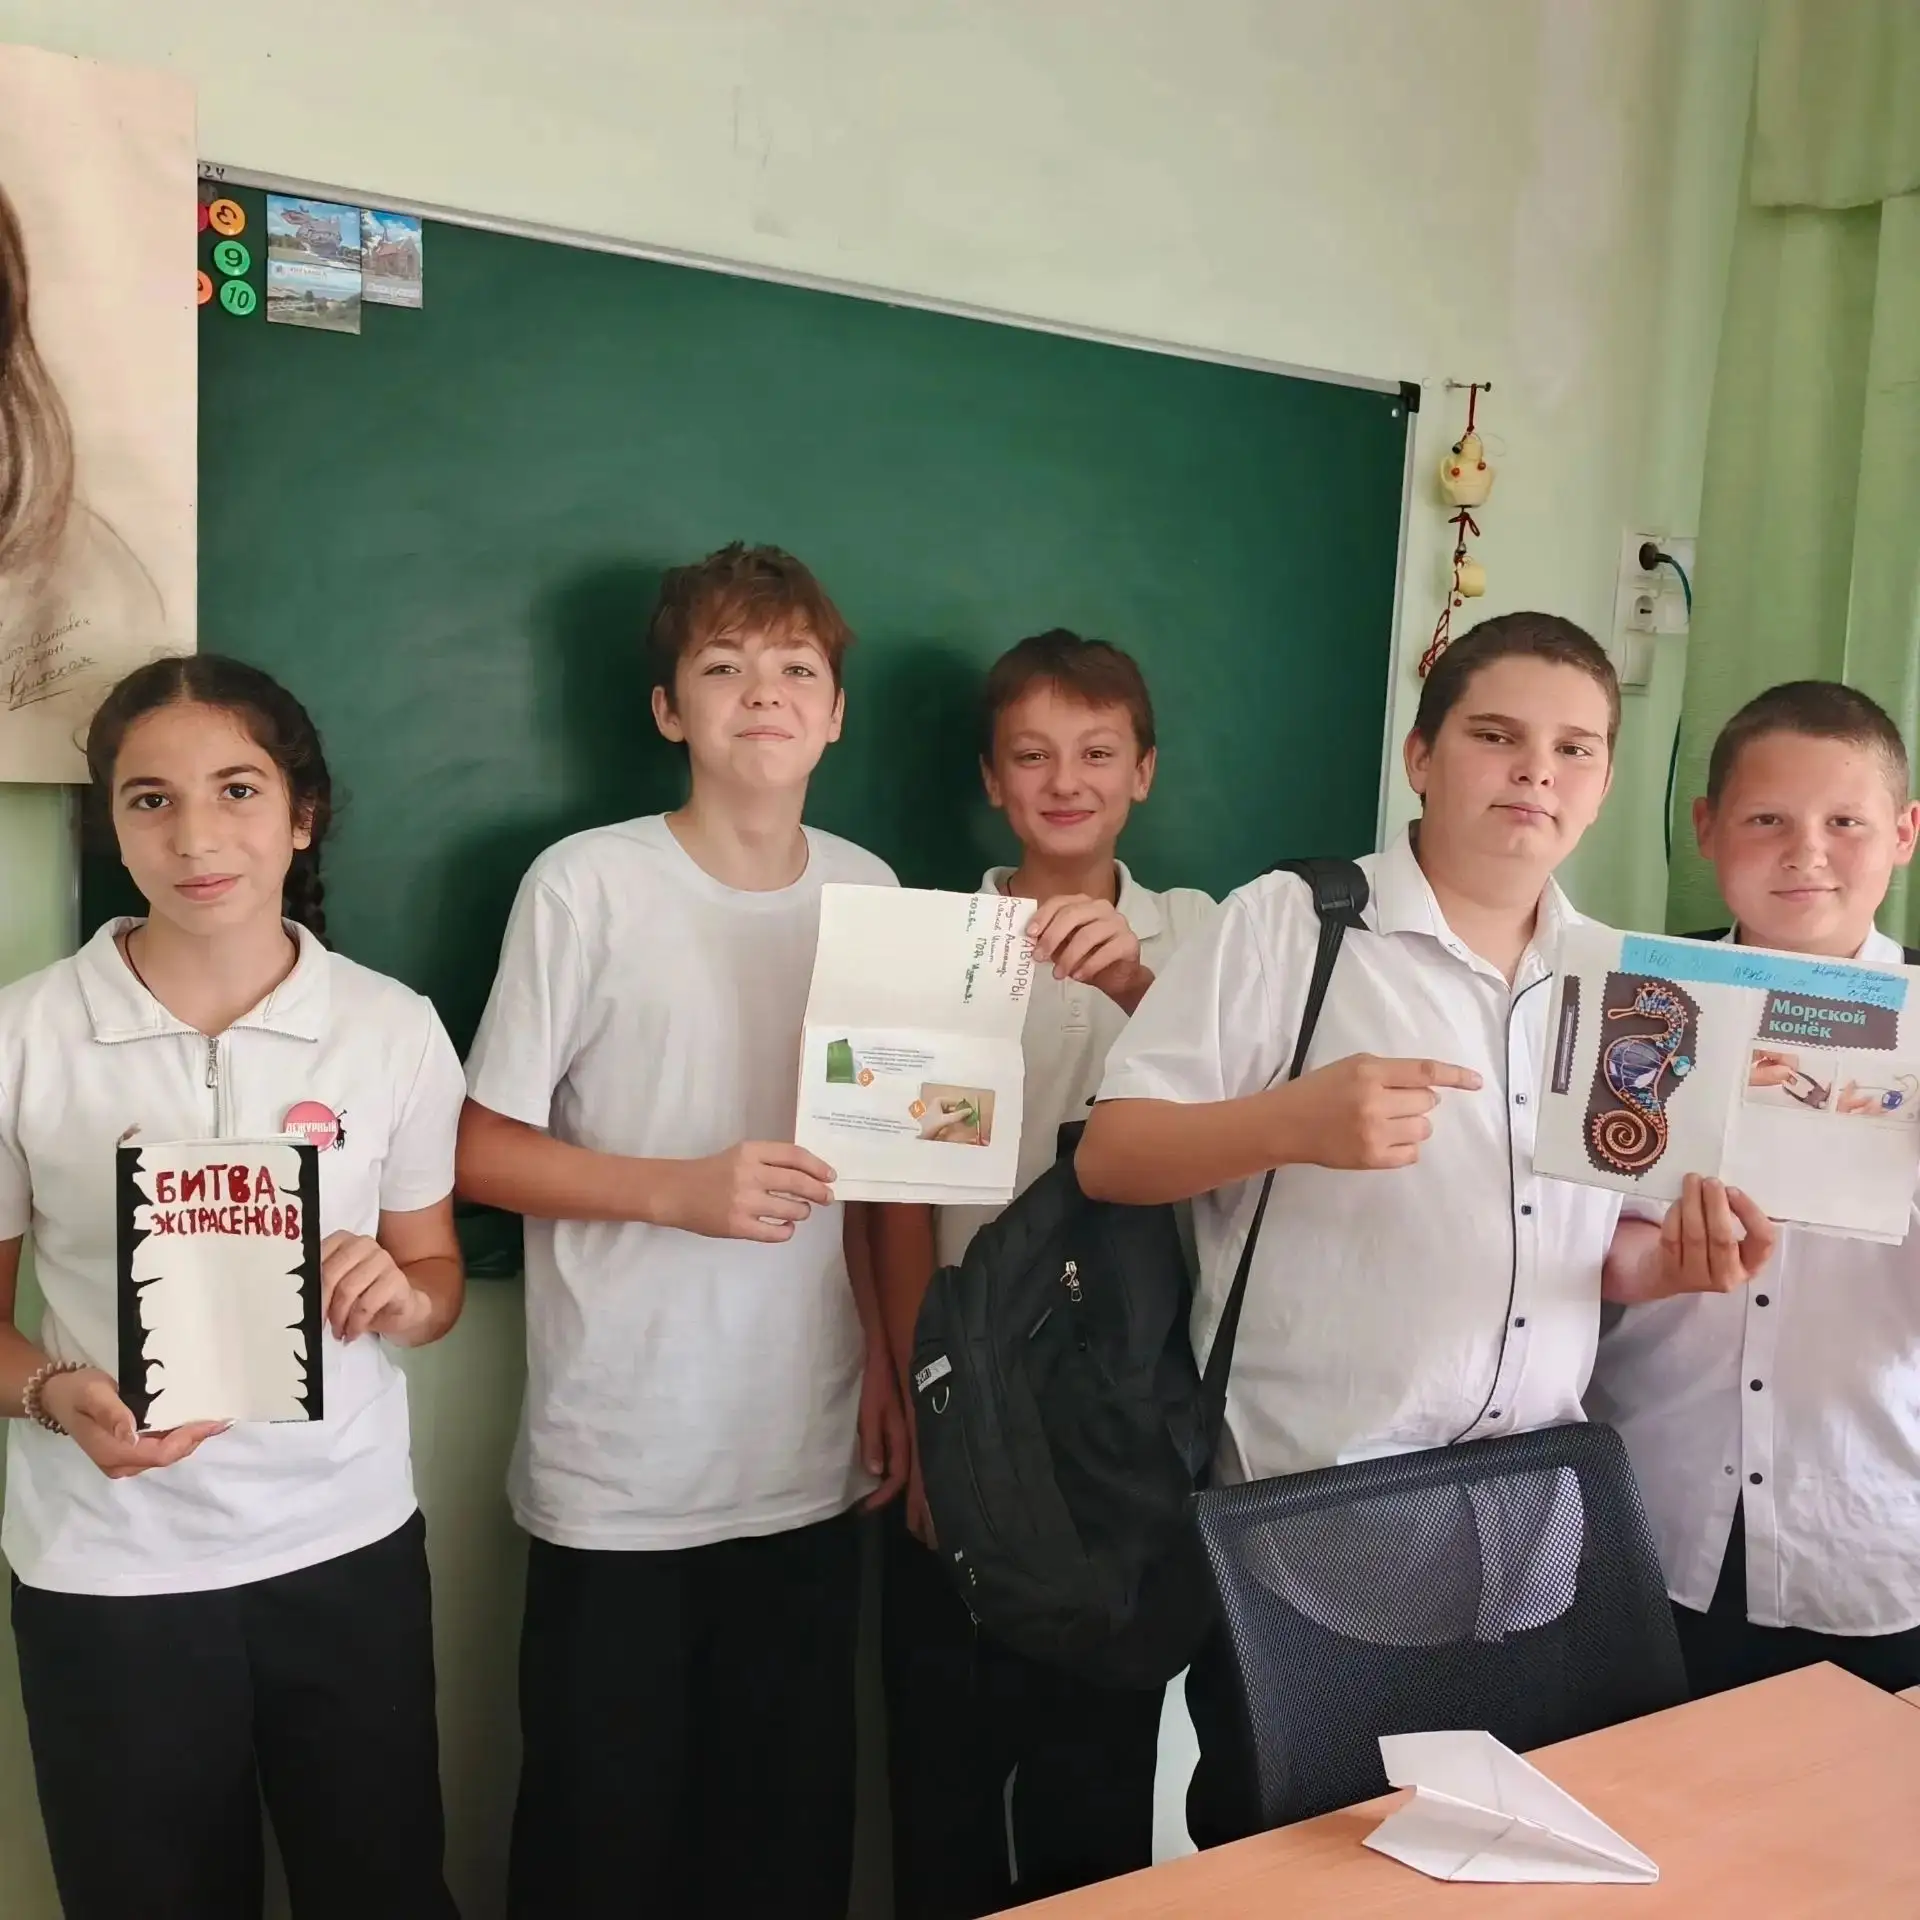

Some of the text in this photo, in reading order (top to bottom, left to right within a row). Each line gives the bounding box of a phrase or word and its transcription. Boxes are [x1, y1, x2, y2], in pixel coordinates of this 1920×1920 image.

[224, 248, 243, 268] 9
[228, 286, 250, 309] 10
[1010, 939, 1036, 1001] АВТОРЫ:
[1771, 998, 1867, 1026] Морской
[1768, 1018, 1833, 1040] конёк
[286, 1120, 337, 1136] ДЕЖУРНЫЙ
[156, 1163, 276, 1204] БИТВА
[150, 1203, 301, 1241] ЭКСТРАСЕНСОВ
